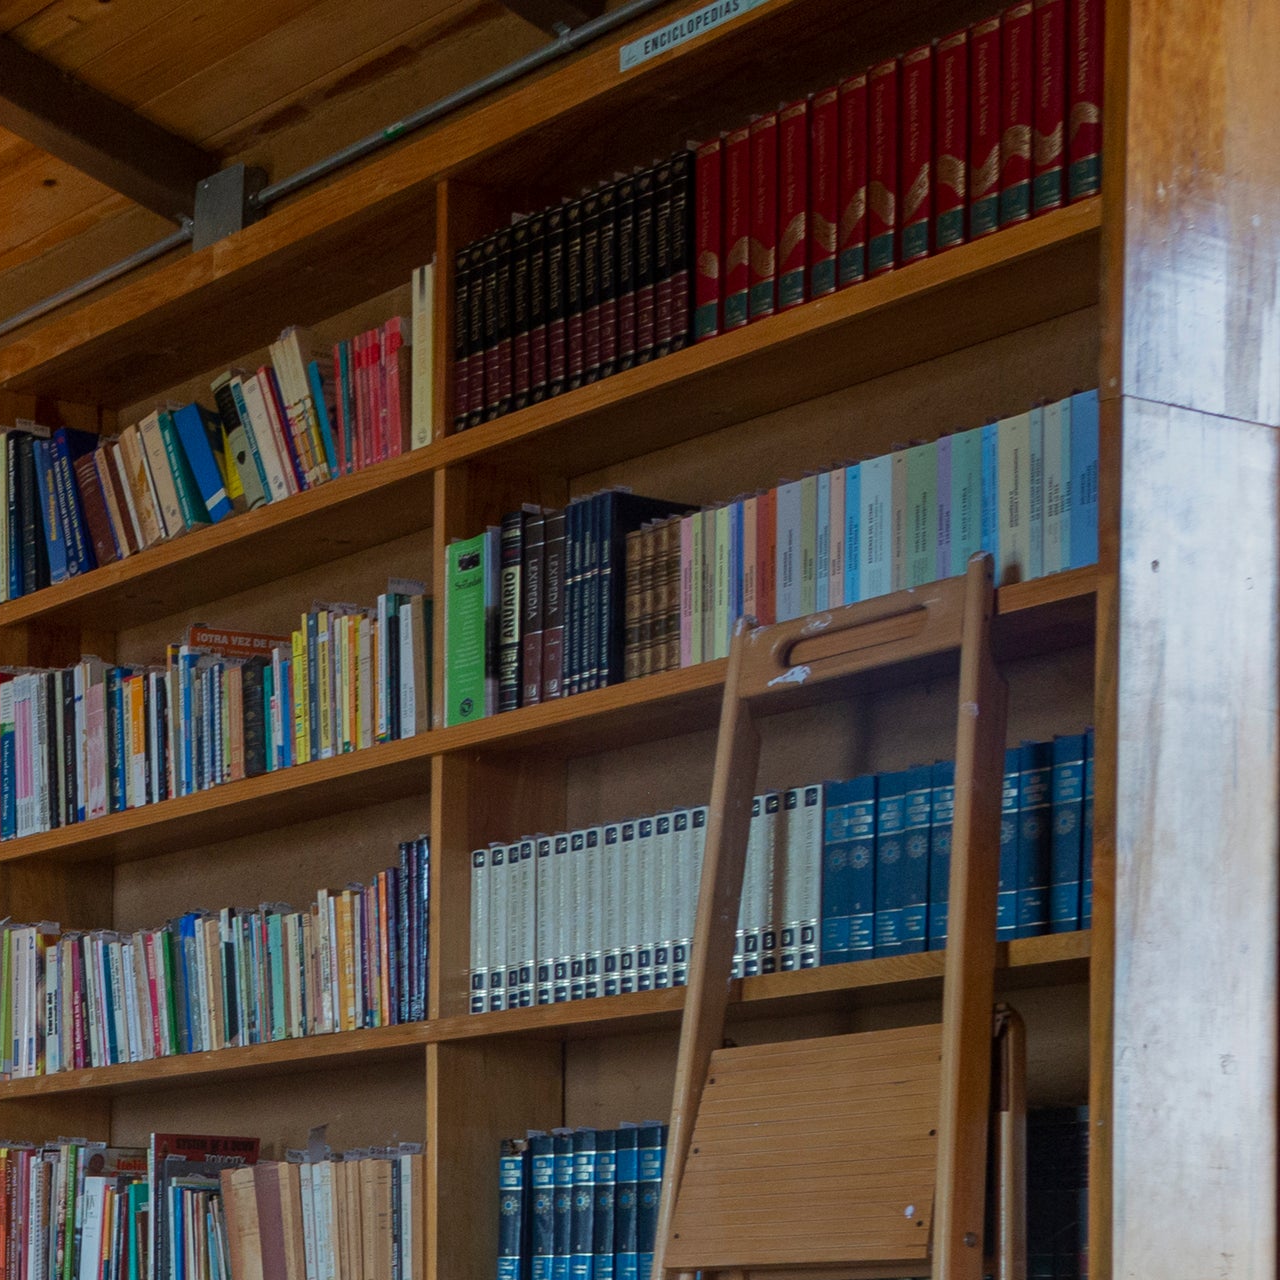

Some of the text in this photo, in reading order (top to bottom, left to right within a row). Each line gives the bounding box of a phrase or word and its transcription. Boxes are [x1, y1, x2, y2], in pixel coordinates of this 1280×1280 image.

[644, 0, 739, 55] ENCICLOPEDIAS
[503, 571, 515, 638] ANUARIO
[527, 558, 538, 620] LEXIPEDIA
[548, 553, 558, 615] LEXIPEDIA
[230, 634, 252, 646] VEZ
[254, 637, 267, 648] DE
